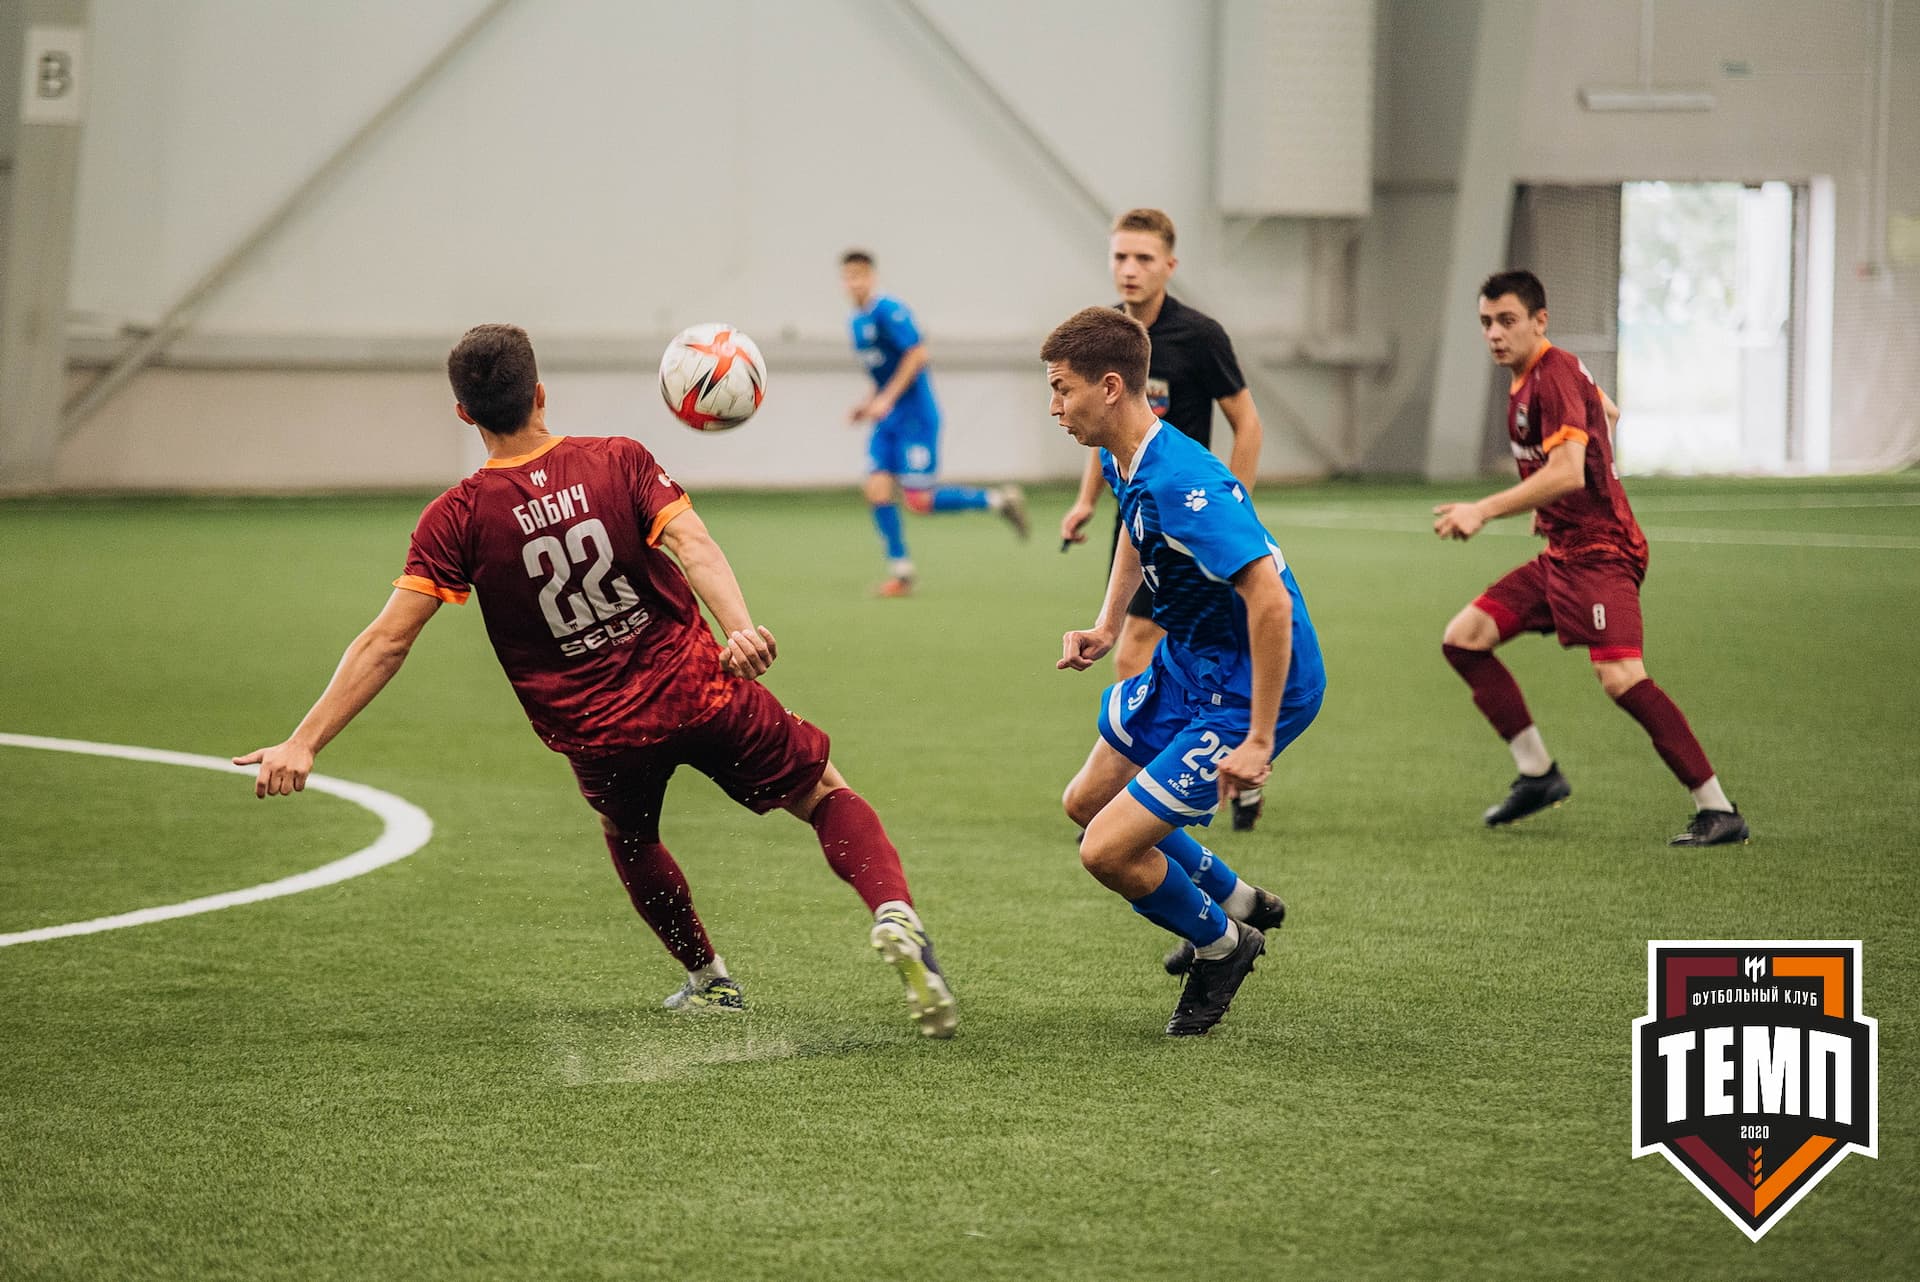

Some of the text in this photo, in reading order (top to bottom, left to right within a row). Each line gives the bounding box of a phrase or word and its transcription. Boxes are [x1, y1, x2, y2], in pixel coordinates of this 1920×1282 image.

[512, 483, 590, 535] БАБИЧ
[522, 518, 640, 638] 22
[1592, 603, 1606, 630] 8
[1181, 730, 1234, 782] 25
